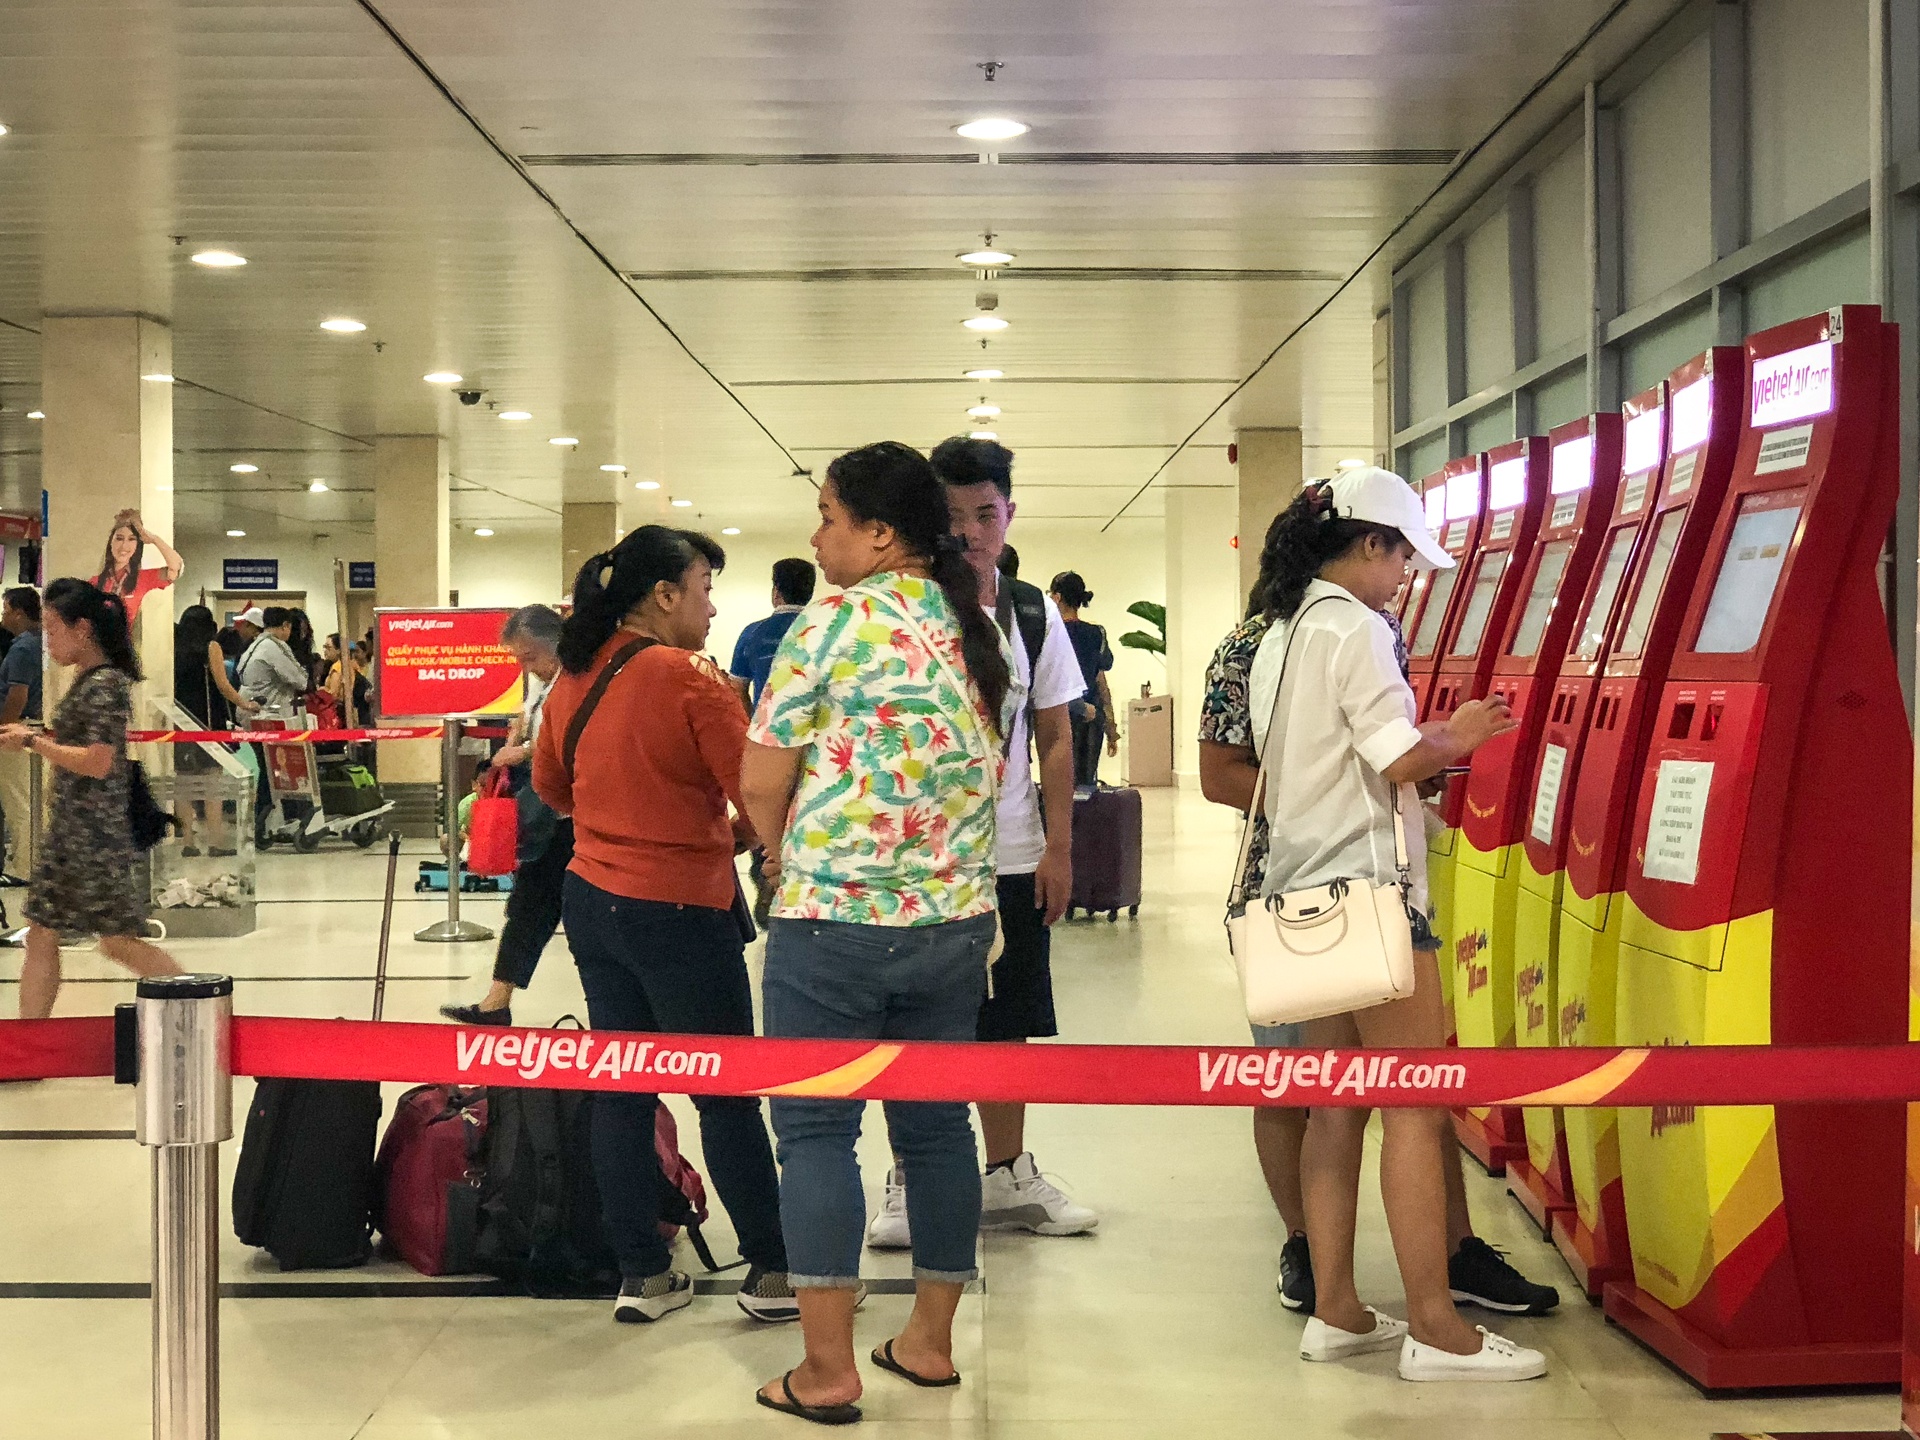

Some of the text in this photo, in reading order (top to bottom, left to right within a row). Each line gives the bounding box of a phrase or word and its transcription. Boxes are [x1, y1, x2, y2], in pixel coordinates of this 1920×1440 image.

[1830, 315, 1841, 337] 24
[474, 655, 517, 665] CHECK-IN
[418, 667, 486, 681] BAG DROP
